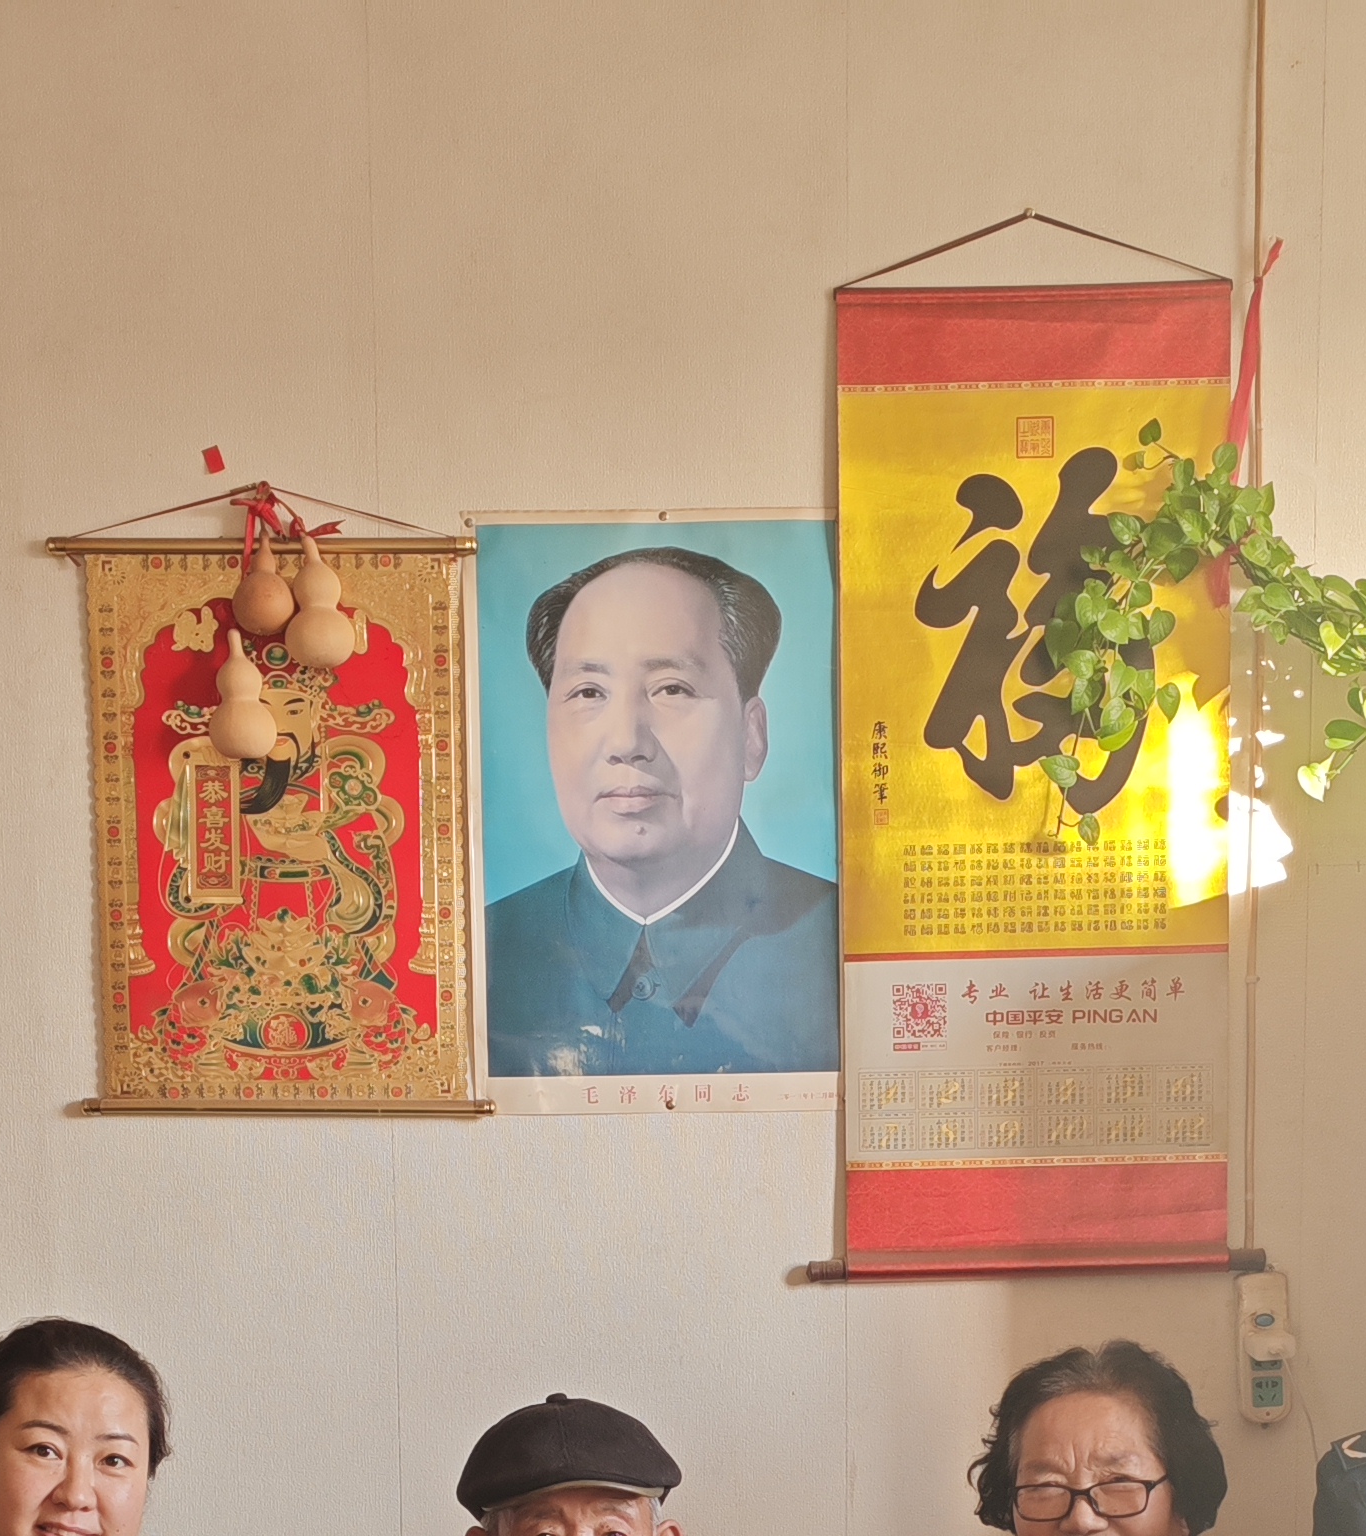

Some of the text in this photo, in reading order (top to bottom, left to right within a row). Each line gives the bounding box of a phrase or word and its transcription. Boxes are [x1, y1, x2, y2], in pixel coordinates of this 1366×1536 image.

[198, 780, 229, 874] 恭喜发财
[961, 976, 1185, 1004] 专业 让生活更简单
[986, 1009, 1063, 1026] 中国平安
[582, 1083, 750, 1105] 毛泽东同志
